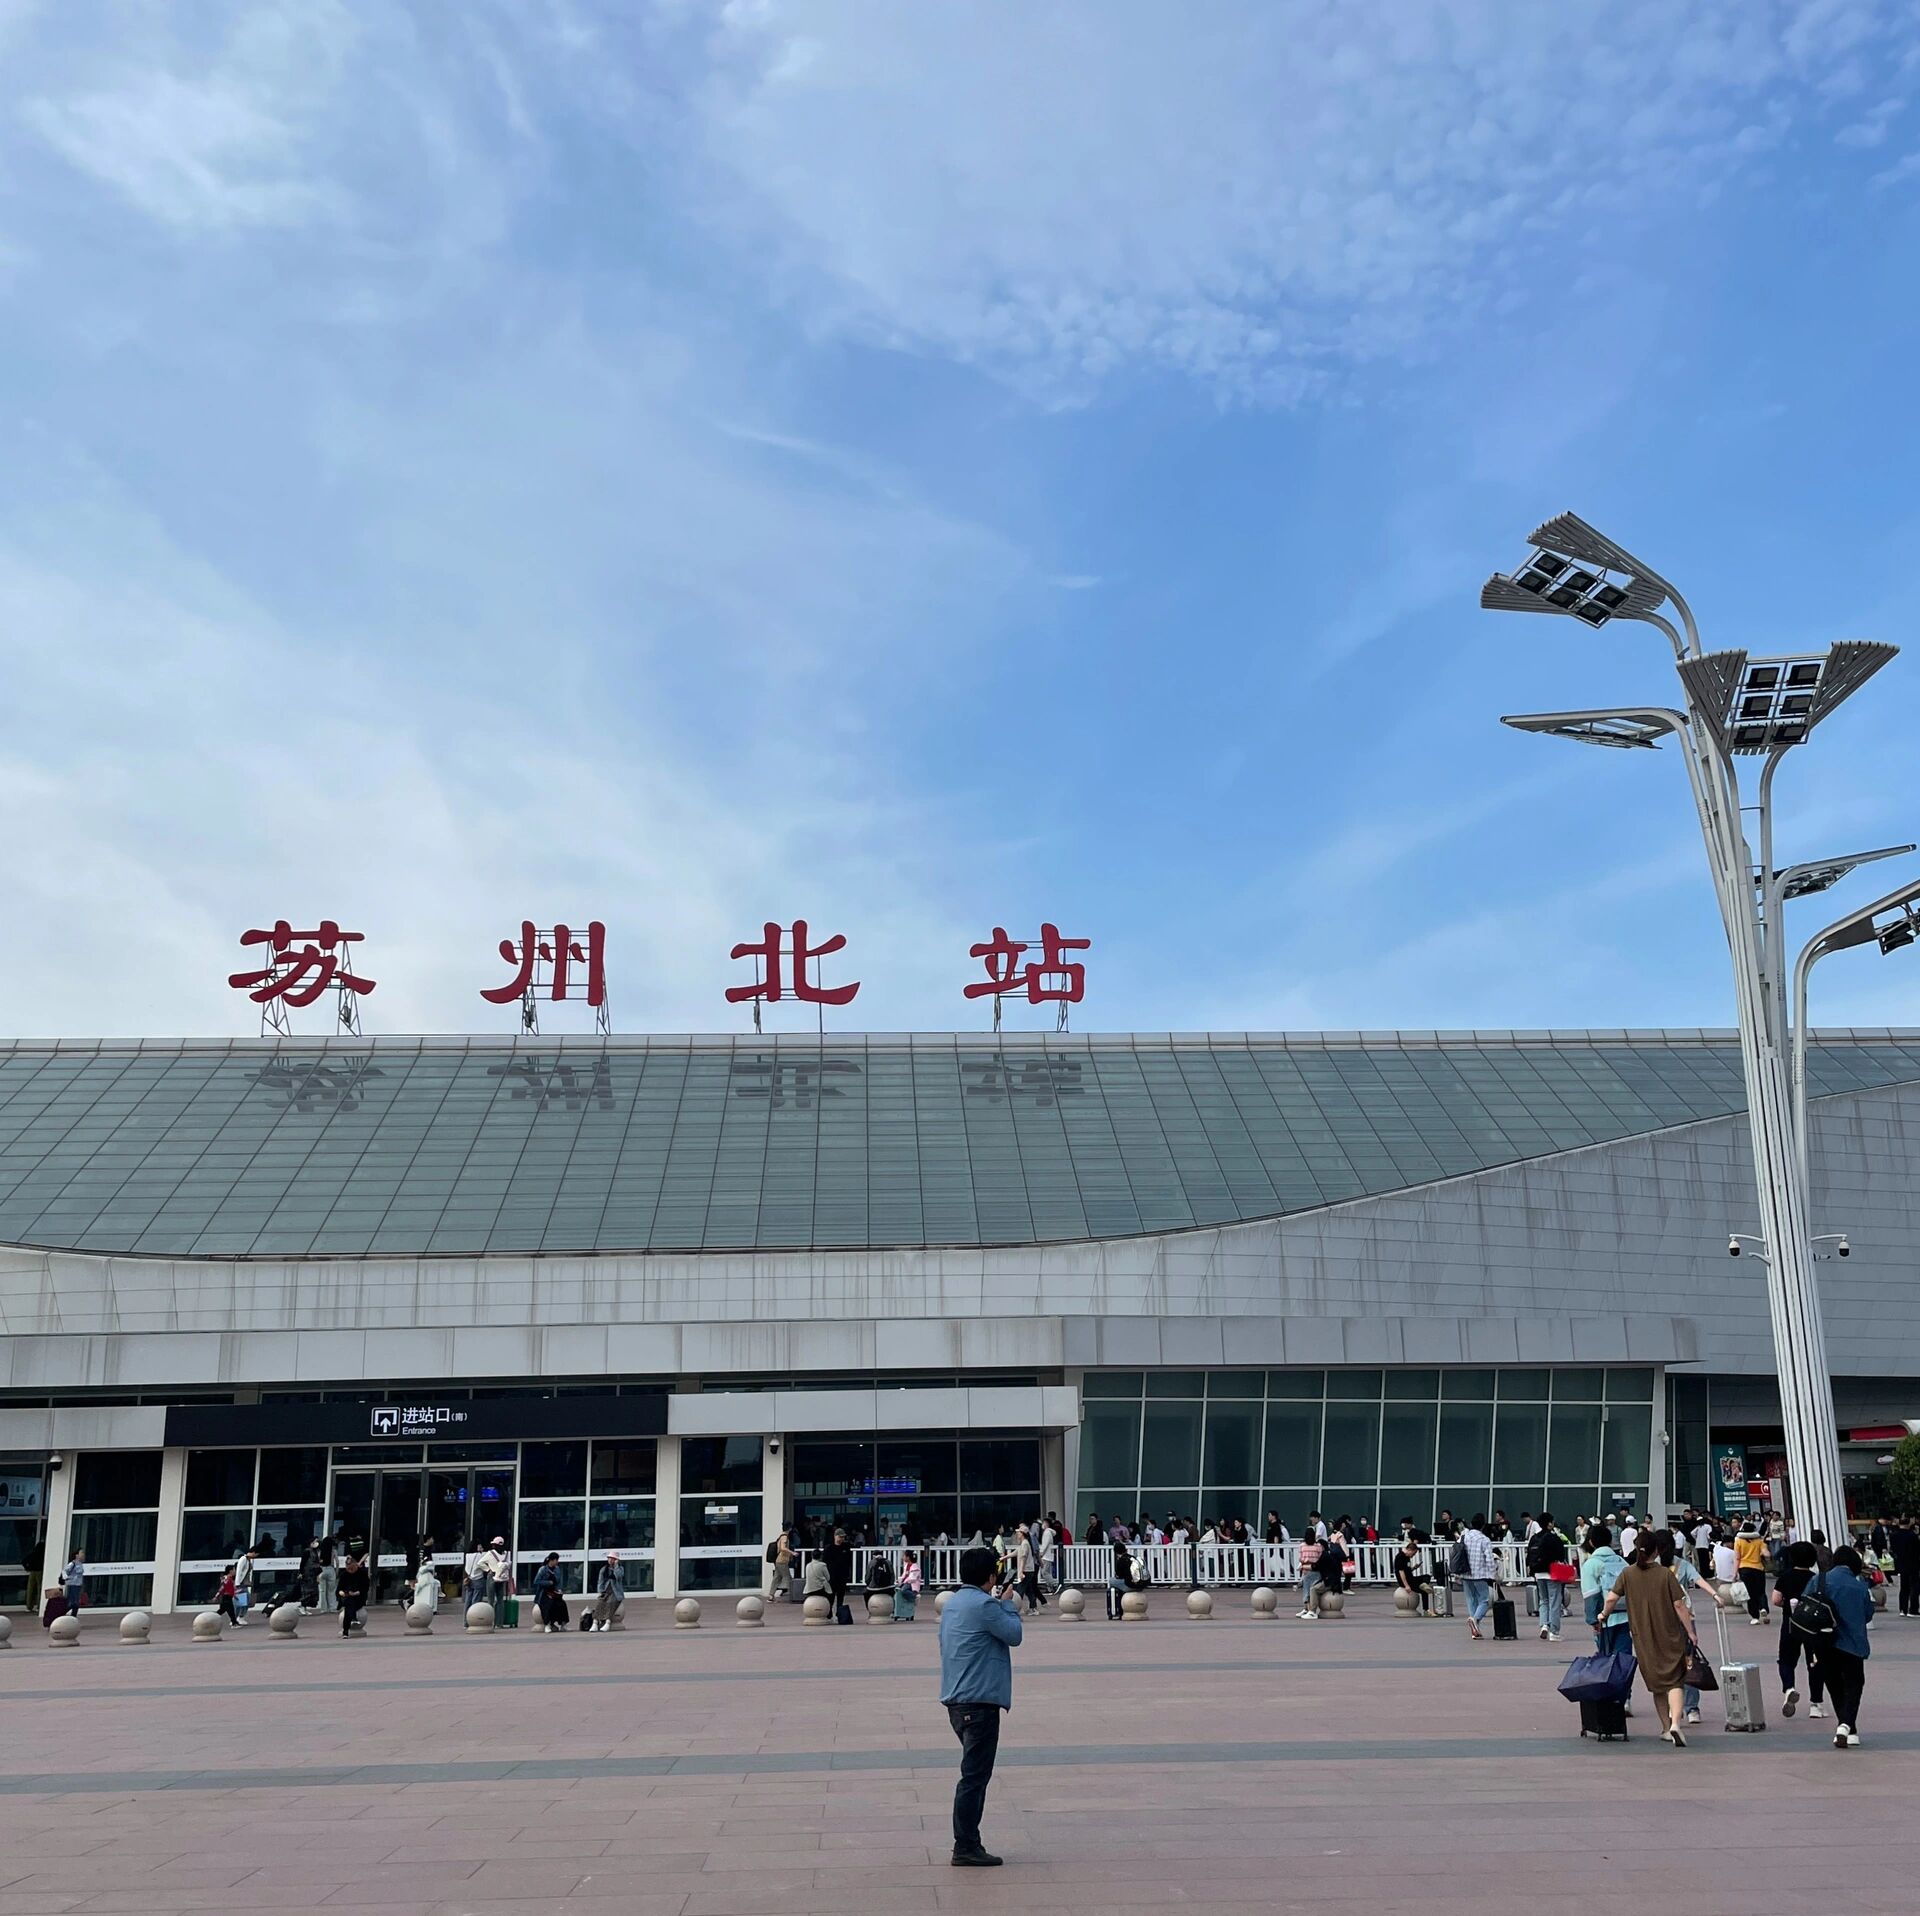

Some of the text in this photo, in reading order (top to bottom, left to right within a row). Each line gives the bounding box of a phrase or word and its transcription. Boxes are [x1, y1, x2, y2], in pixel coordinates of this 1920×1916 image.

[228, 920, 1091, 1006] 苏州北站
[402, 1427, 436, 1435] Entrance
